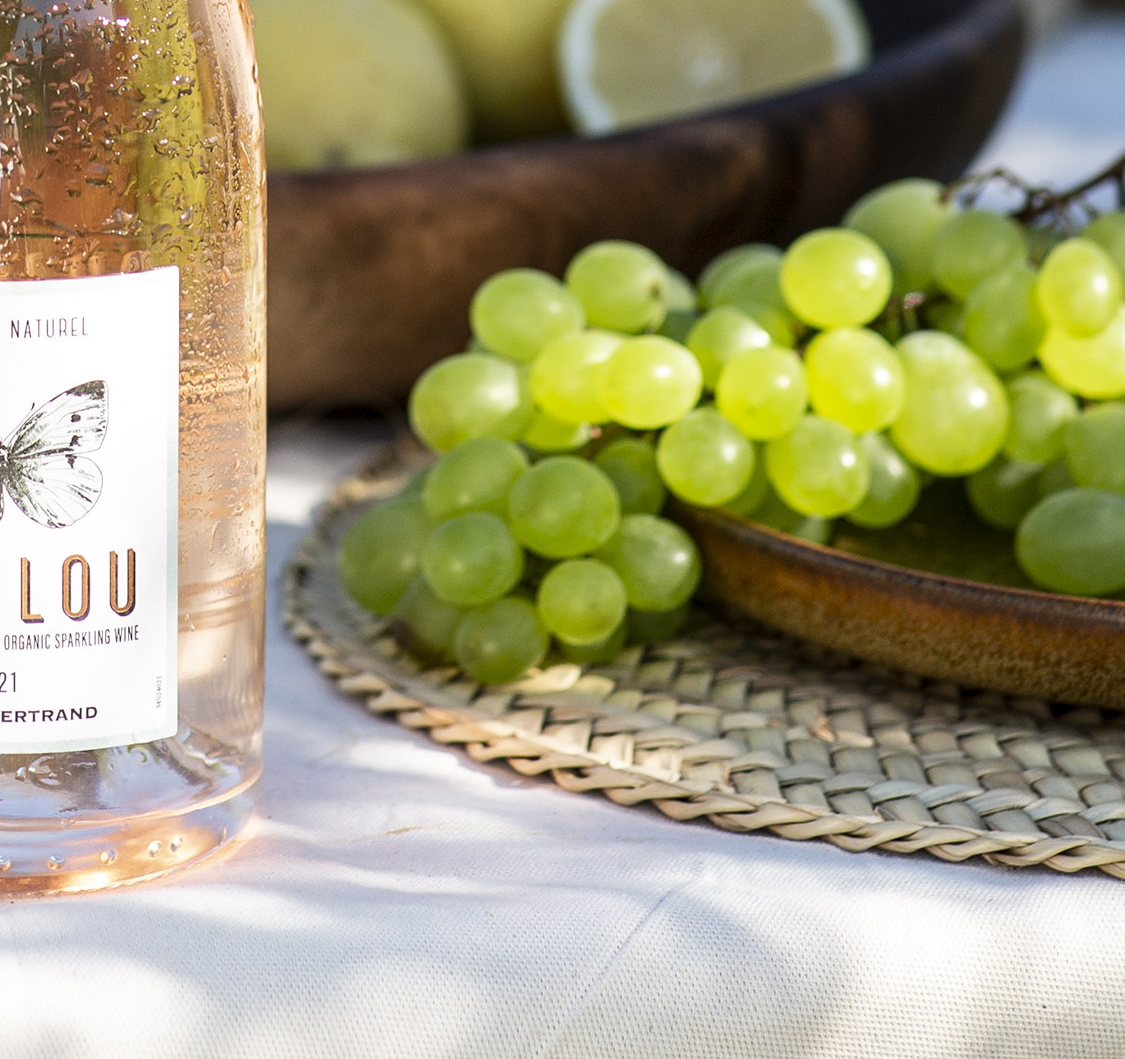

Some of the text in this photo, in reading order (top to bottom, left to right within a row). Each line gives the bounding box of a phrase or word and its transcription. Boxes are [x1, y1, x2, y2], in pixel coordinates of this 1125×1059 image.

[11, 316, 88, 338] NATUREL
[3, 633, 51, 651] ORGANIC
[54, 628, 111, 650] SPARKLING
[114, 624, 139, 644] WINE
